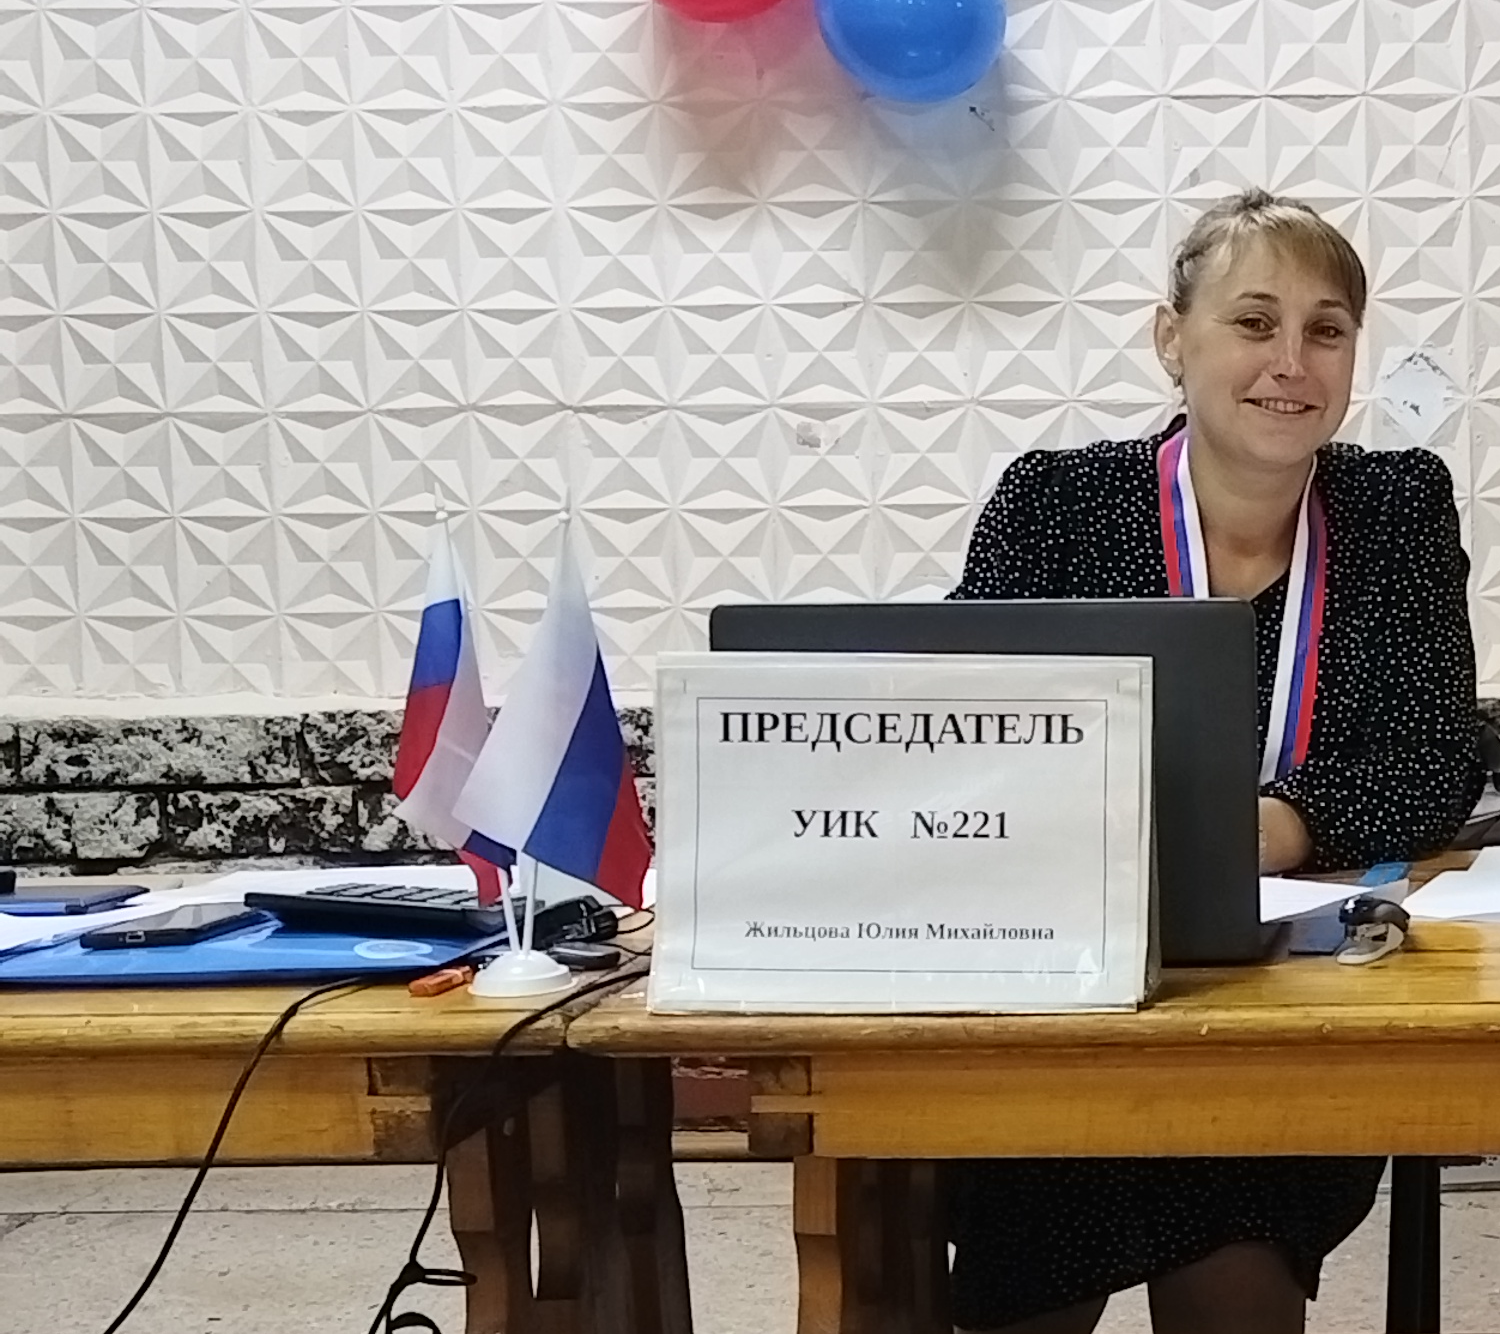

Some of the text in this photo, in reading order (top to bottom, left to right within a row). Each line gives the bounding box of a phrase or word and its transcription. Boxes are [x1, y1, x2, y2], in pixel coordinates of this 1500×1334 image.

[719, 711, 1084, 753] ПРЕДСЕДАТЕЛЬ
[791, 809, 1010, 840] УИК №221
[744, 920, 1055, 941] Жильцова Юлия Михайловна
